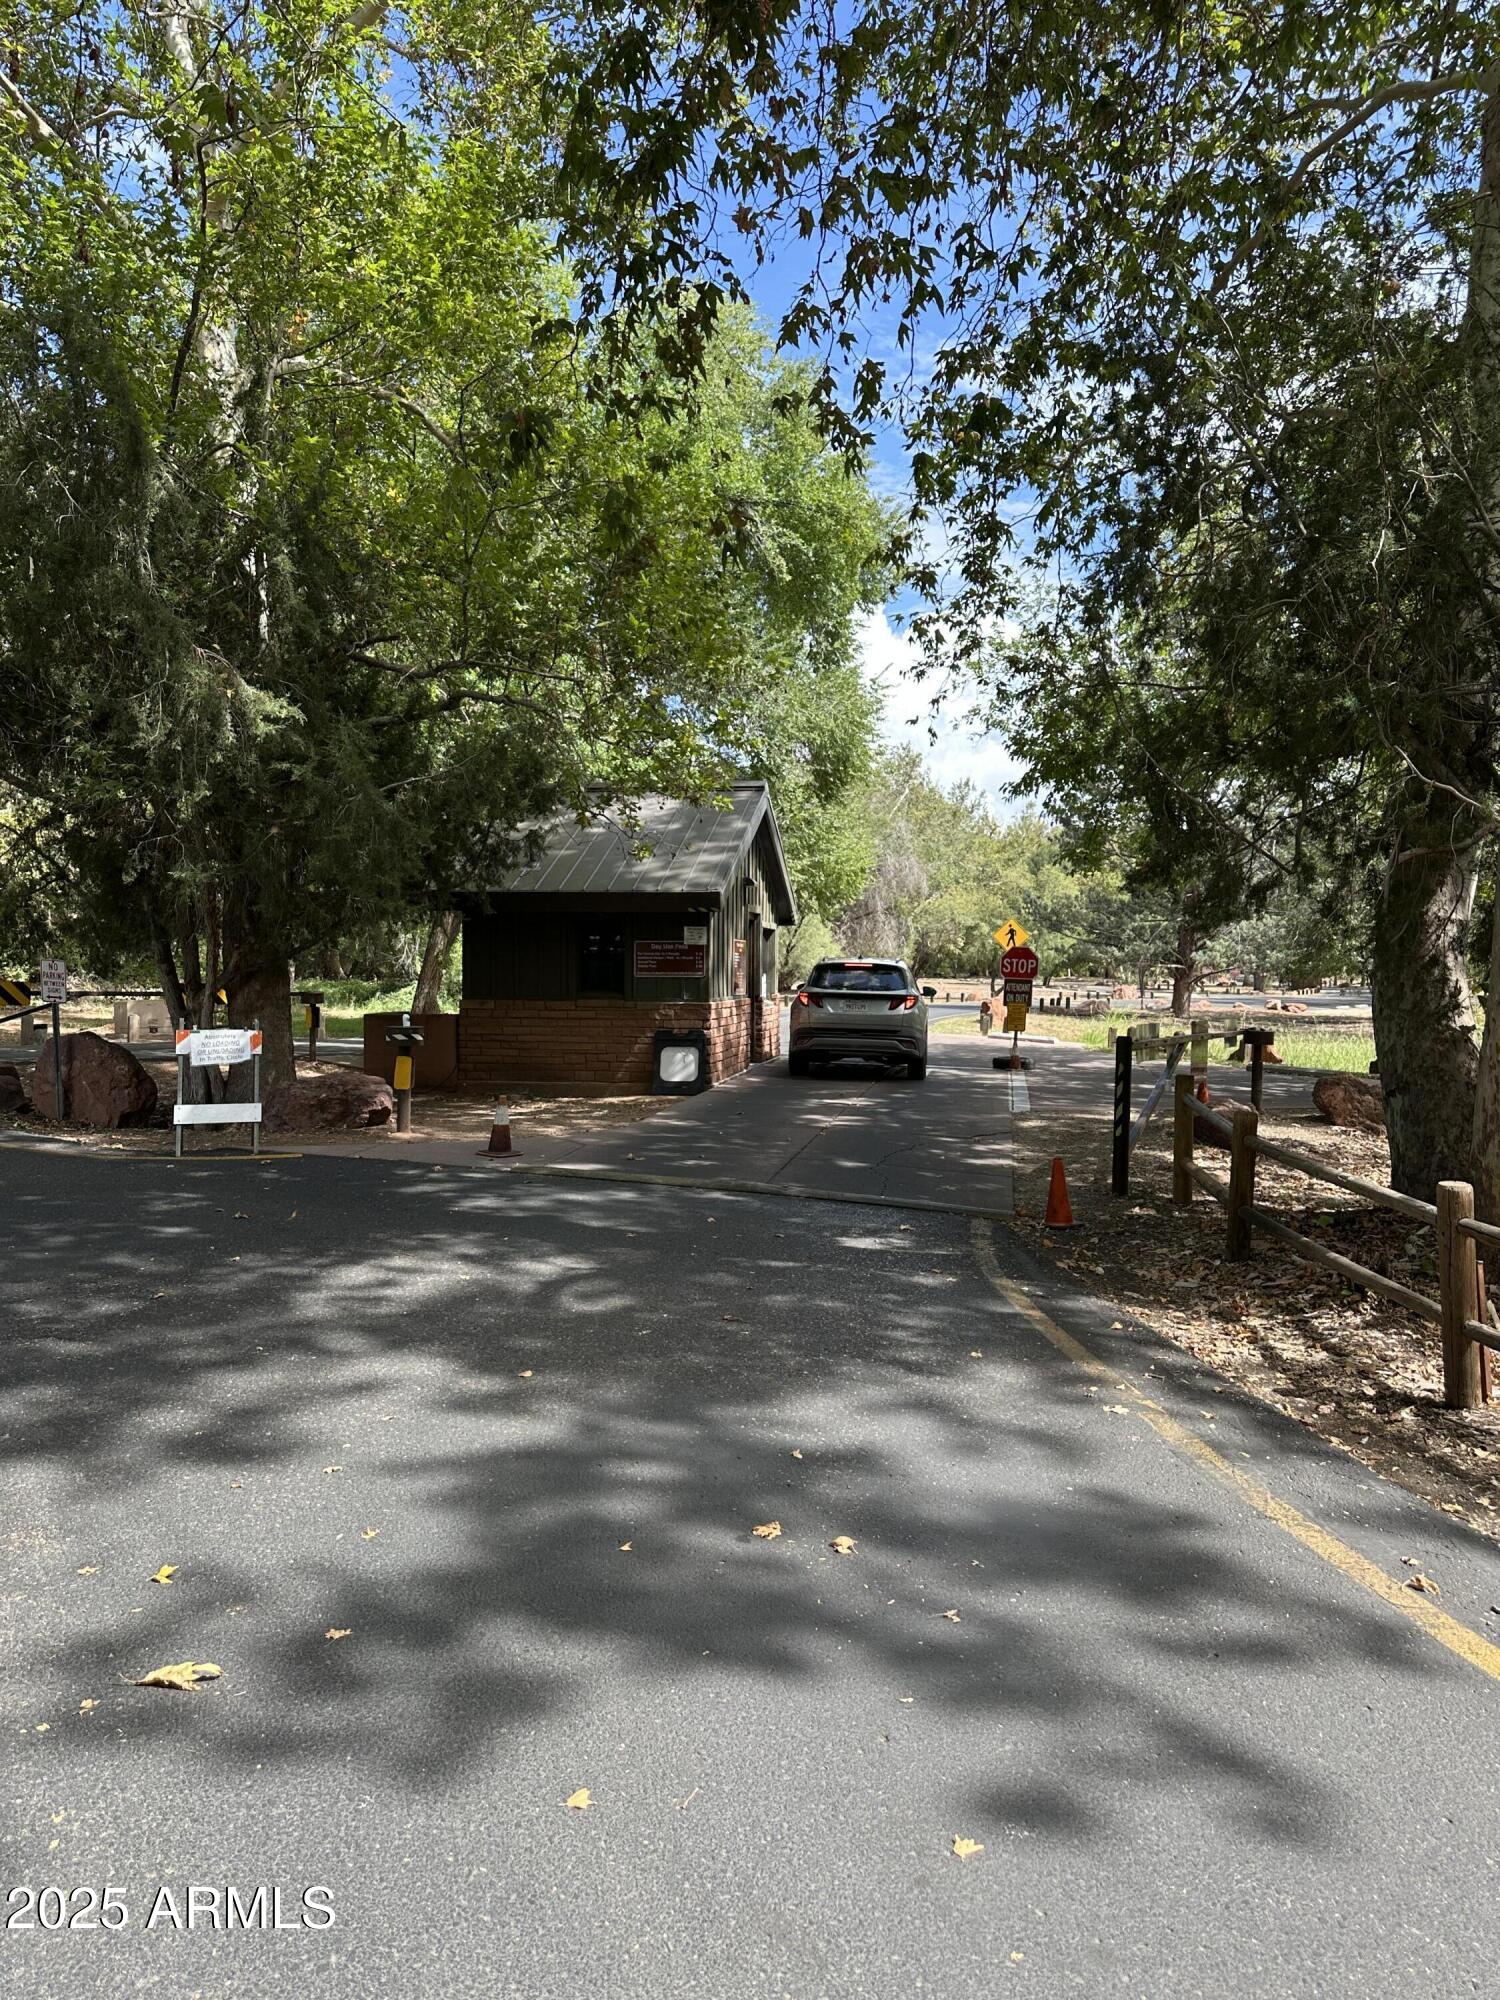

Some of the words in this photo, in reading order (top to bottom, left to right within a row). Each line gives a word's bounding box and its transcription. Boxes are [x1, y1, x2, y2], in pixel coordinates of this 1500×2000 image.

[48, 963, 58, 971] NO
[1003, 959, 1036, 974] STOP
[43, 971, 64, 980] PARKING
[1006, 983, 1031, 992] ATTENDANT
[1015, 994, 1029, 1002] DUTY
[212, 1040, 240, 1048] LOADING
[208, 1047, 244, 1055] UNLOADING
